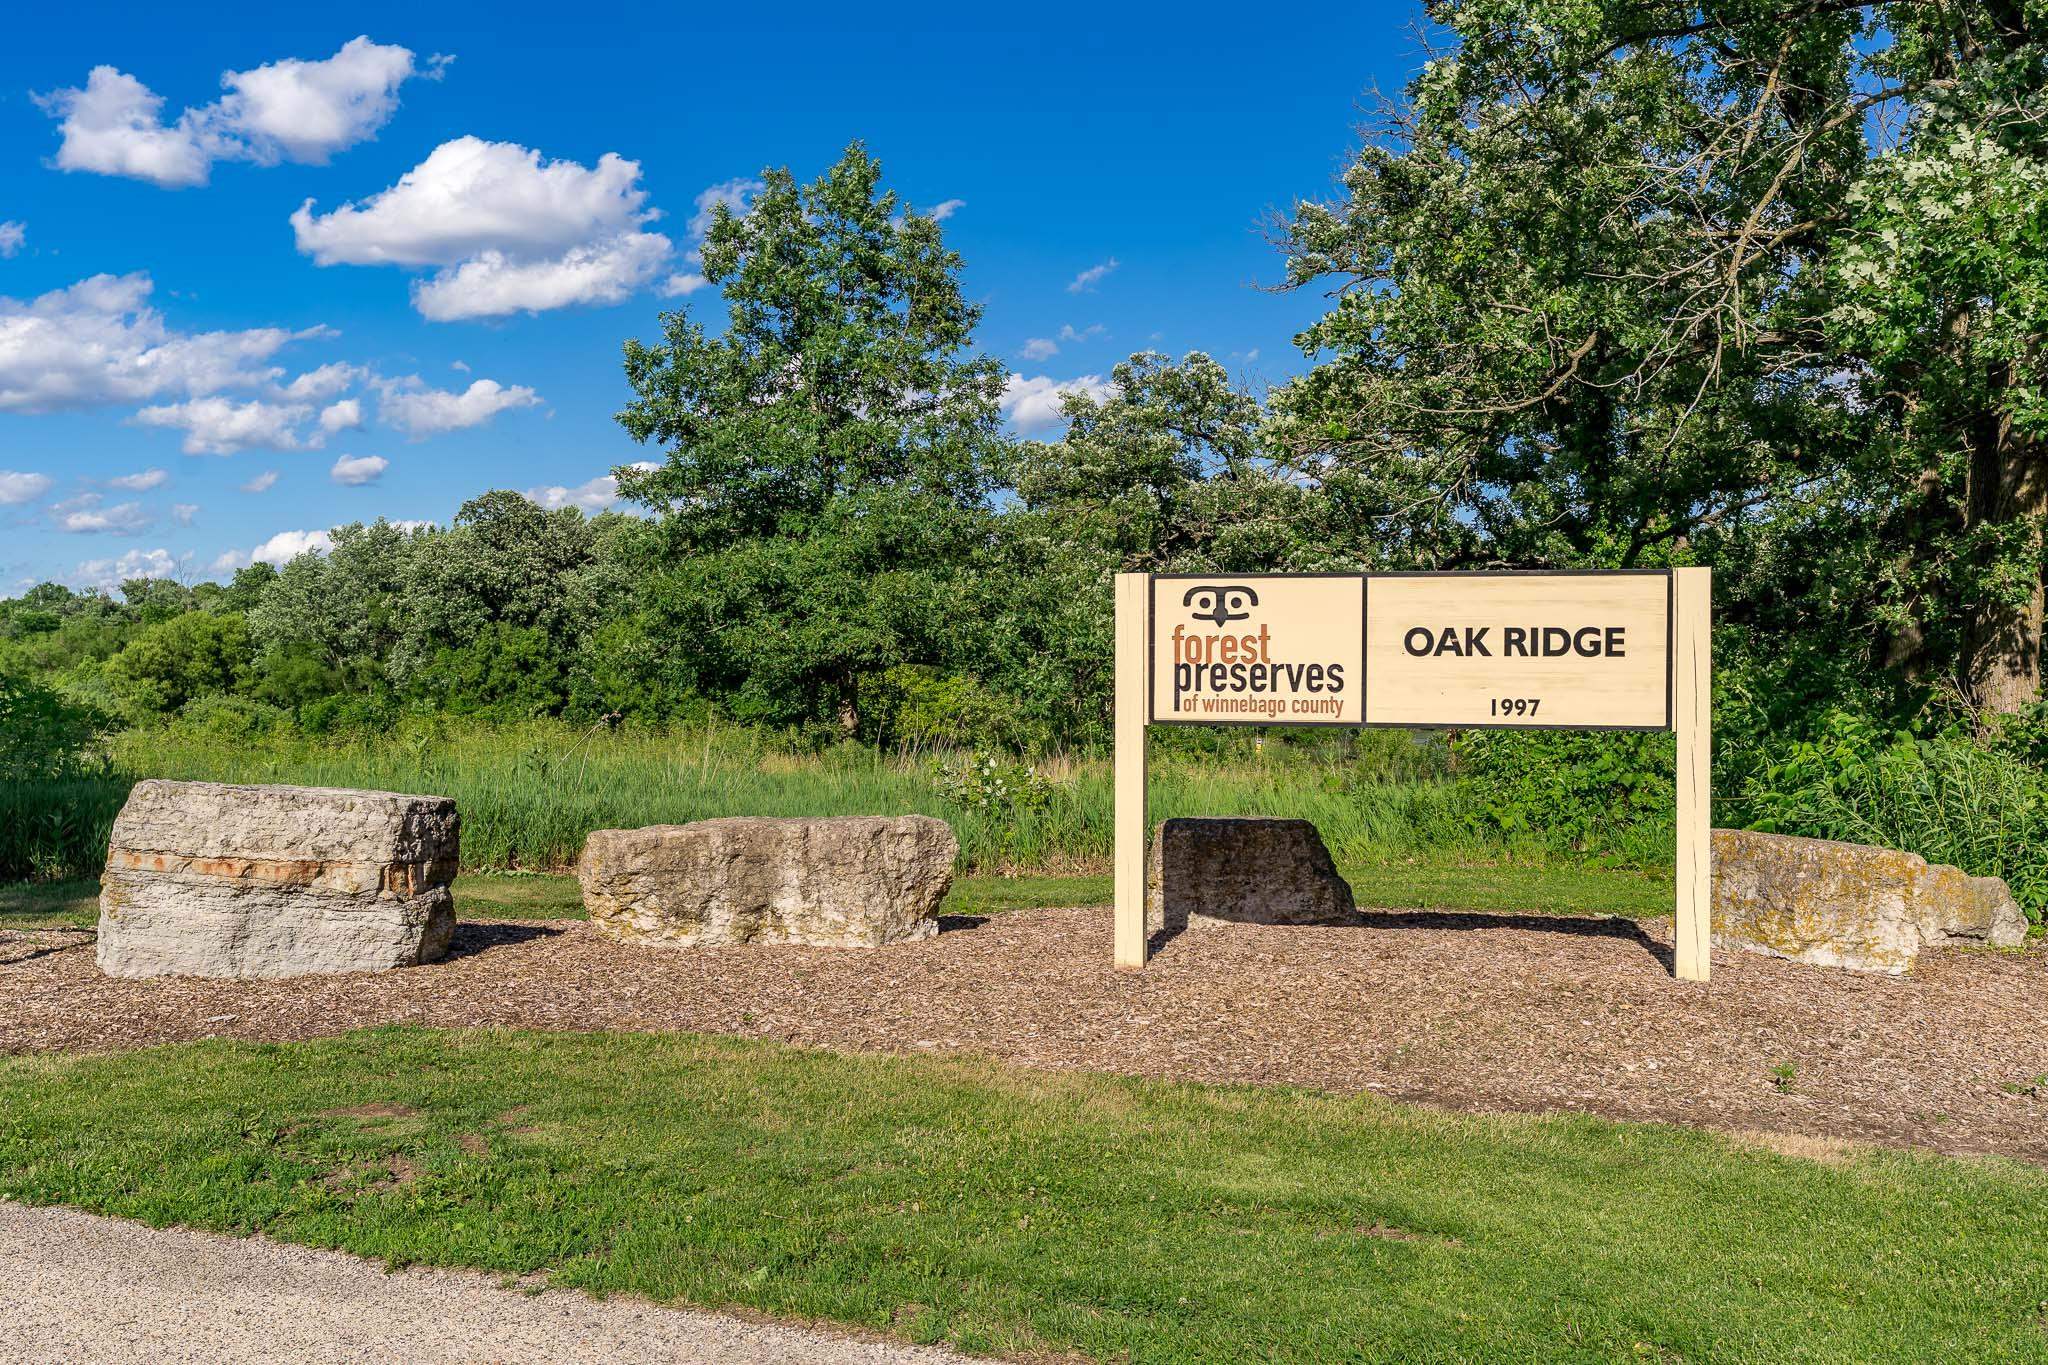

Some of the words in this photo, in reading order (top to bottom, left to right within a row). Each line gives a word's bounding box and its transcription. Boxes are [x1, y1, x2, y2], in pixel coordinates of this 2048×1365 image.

[1172, 624, 1271, 664] forest
[1404, 627, 1493, 657] OAK
[1504, 627, 1626, 657] RIDGE
[1174, 663, 1344, 712] preserves
[1183, 694, 1199, 713] of
[1202, 694, 1286, 718] winnebago
[1292, 696, 1344, 718] county
[1491, 699, 1541, 717] 1997
